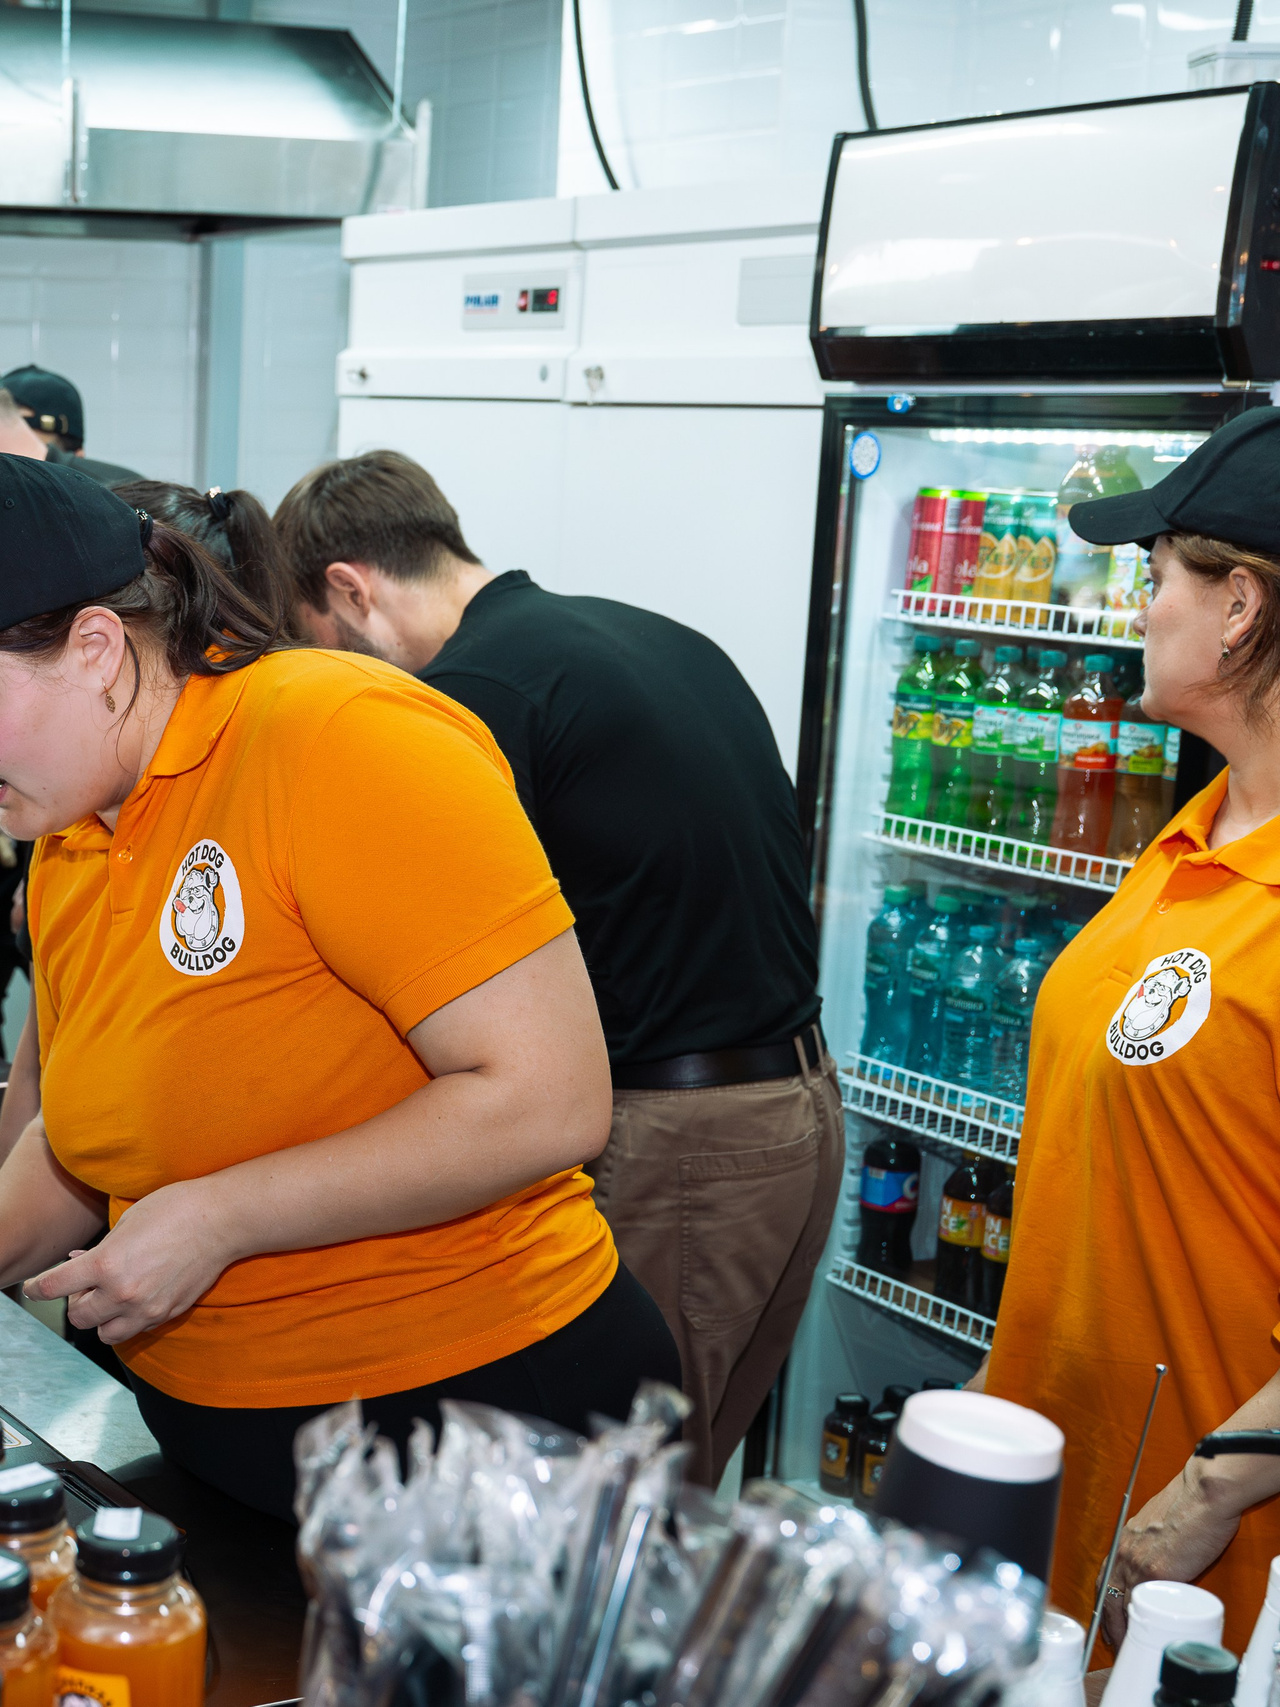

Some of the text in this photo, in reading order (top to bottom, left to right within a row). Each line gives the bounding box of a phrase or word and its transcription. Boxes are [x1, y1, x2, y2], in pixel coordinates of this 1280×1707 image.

[181, 844, 225, 876] HOT DOG
[170, 936, 236, 971] BULLDOG
[1160, 952, 1208, 984] HOT DOG
[1109, 1020, 1164, 1060] BULLDOG
